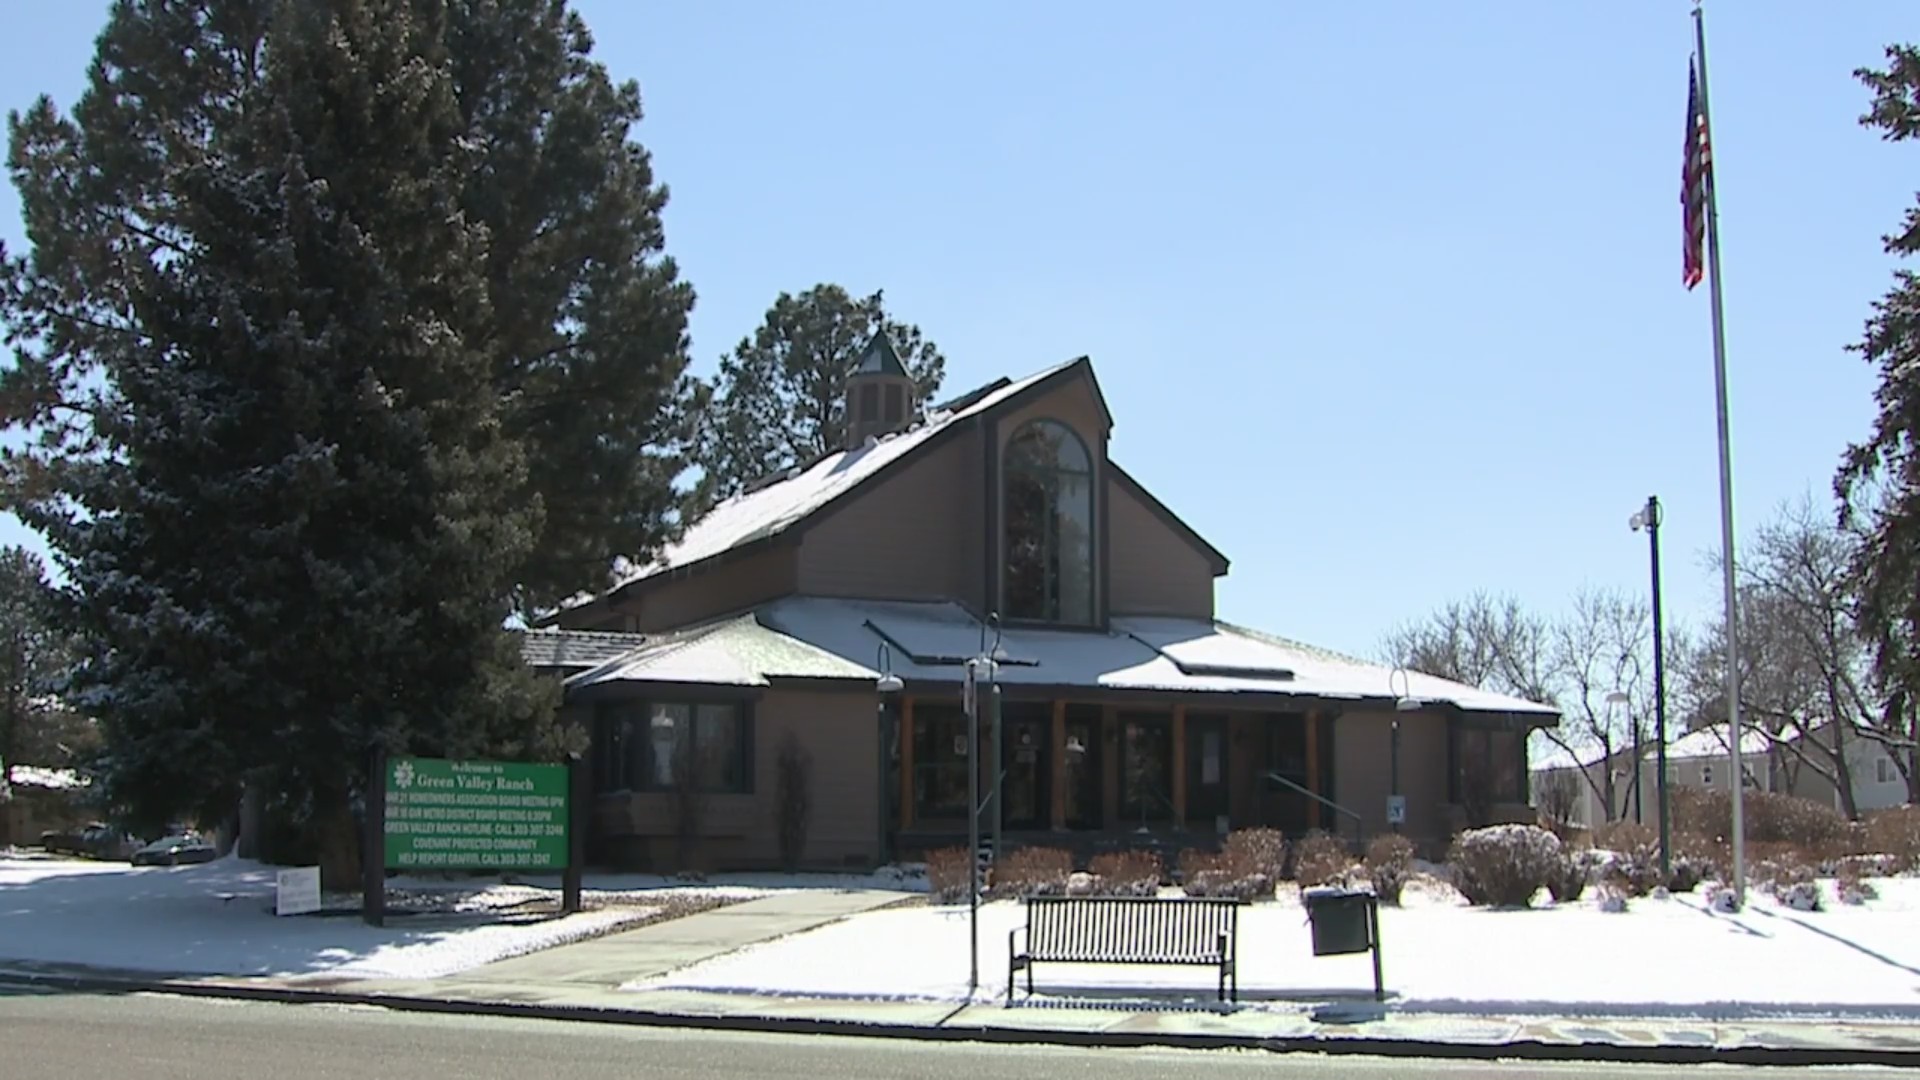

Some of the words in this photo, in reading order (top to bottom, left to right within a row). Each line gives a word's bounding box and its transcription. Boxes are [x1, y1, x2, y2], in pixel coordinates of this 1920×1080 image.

[493, 764, 504, 774] to
[416, 774, 454, 788] Green
[457, 775, 494, 791] Valley
[496, 776, 535, 791] Ranch
[456, 793, 498, 806] ASSOCIATION
[499, 794, 521, 806] BOARD
[521, 795, 549, 807] MEETING
[423, 807, 446, 820] METRO
[446, 808, 475, 820] DISTRICT
[476, 809, 497, 821] BOARD
[498, 810, 526, 821] MEETING
[384, 821, 409, 833] GREEN
[410, 821, 435, 834] VALLEY
[436, 822, 461, 834] RANCH
[494, 823, 512, 835] CALL
[413, 836, 451, 849] COVENANT
[452, 837, 493, 850] PROTECTED
[493, 838, 537, 850] COMMUNITY
[398, 852, 417, 864] HELP
[418, 852, 447, 865] REPORT
[481, 853, 499, 864] CALL
